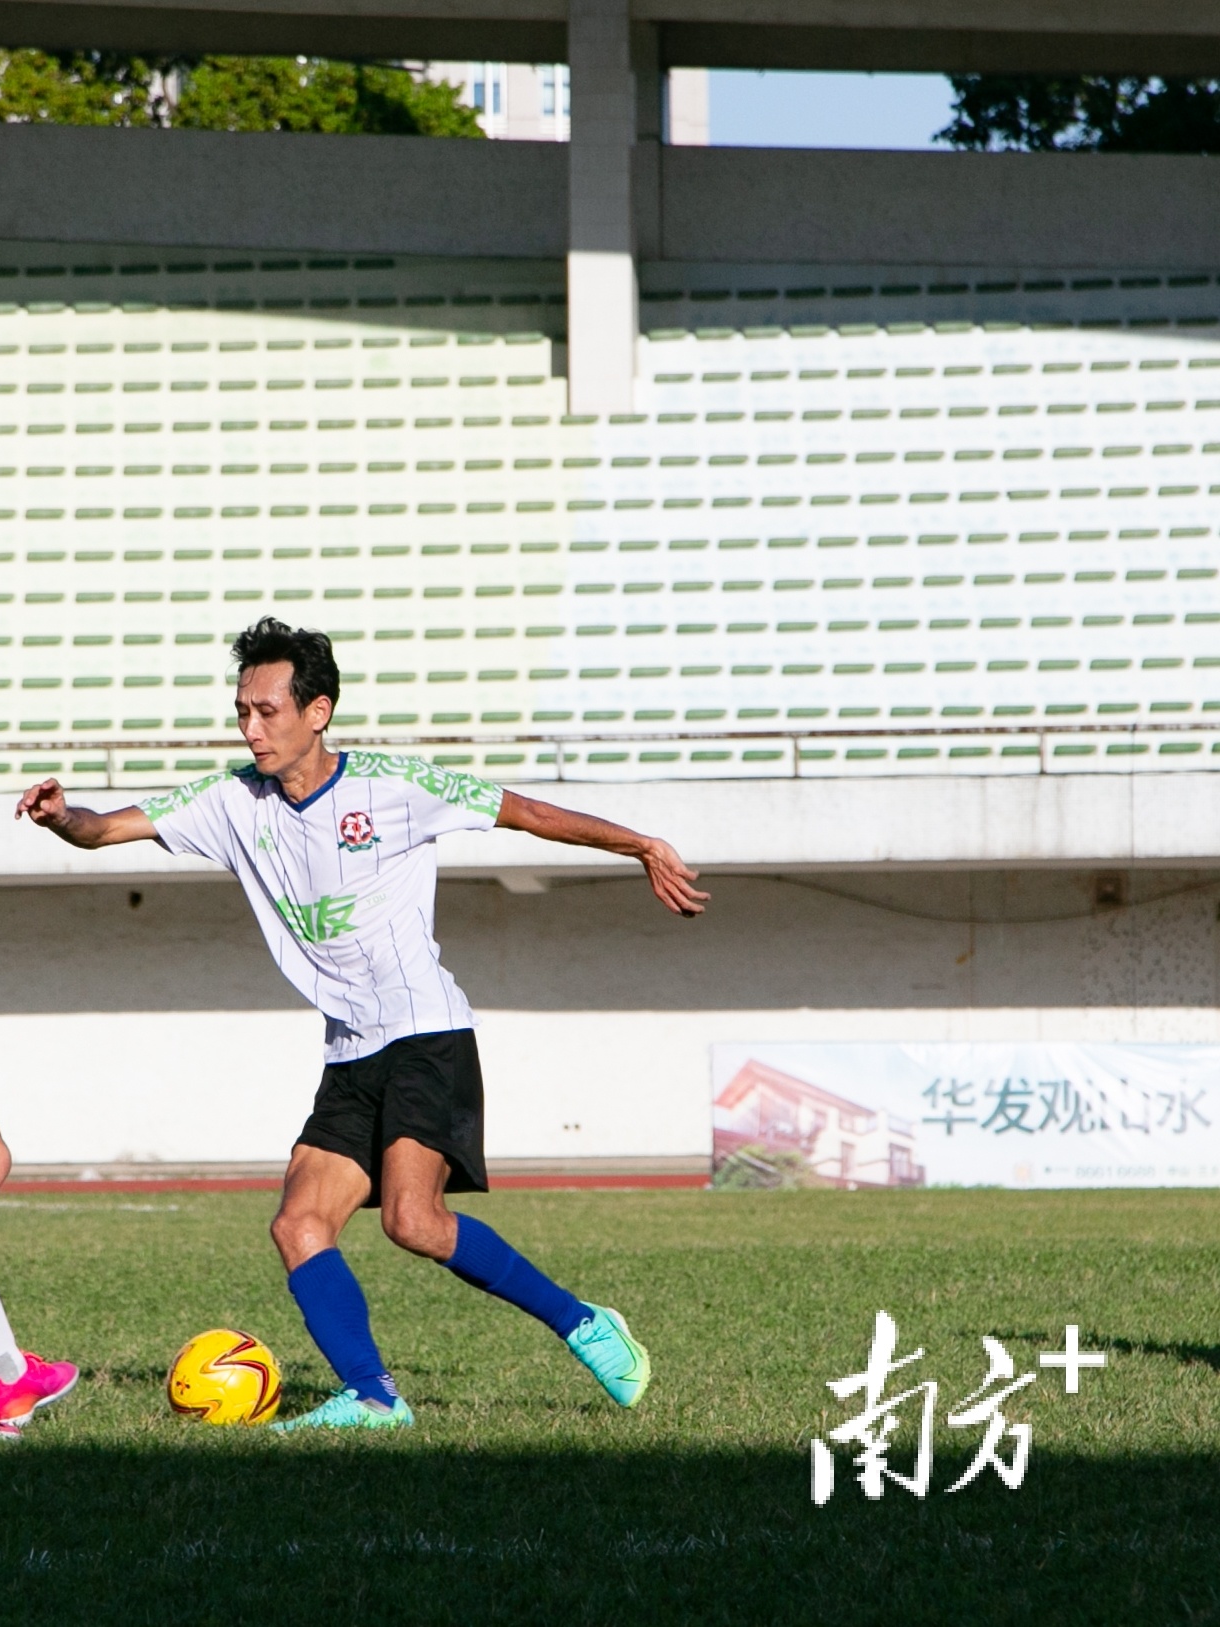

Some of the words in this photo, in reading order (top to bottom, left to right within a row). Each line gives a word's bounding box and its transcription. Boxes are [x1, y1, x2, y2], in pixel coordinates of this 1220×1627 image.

[366, 893, 387, 905] YOU
[922, 1076, 1212, 1136] 华发观山水
